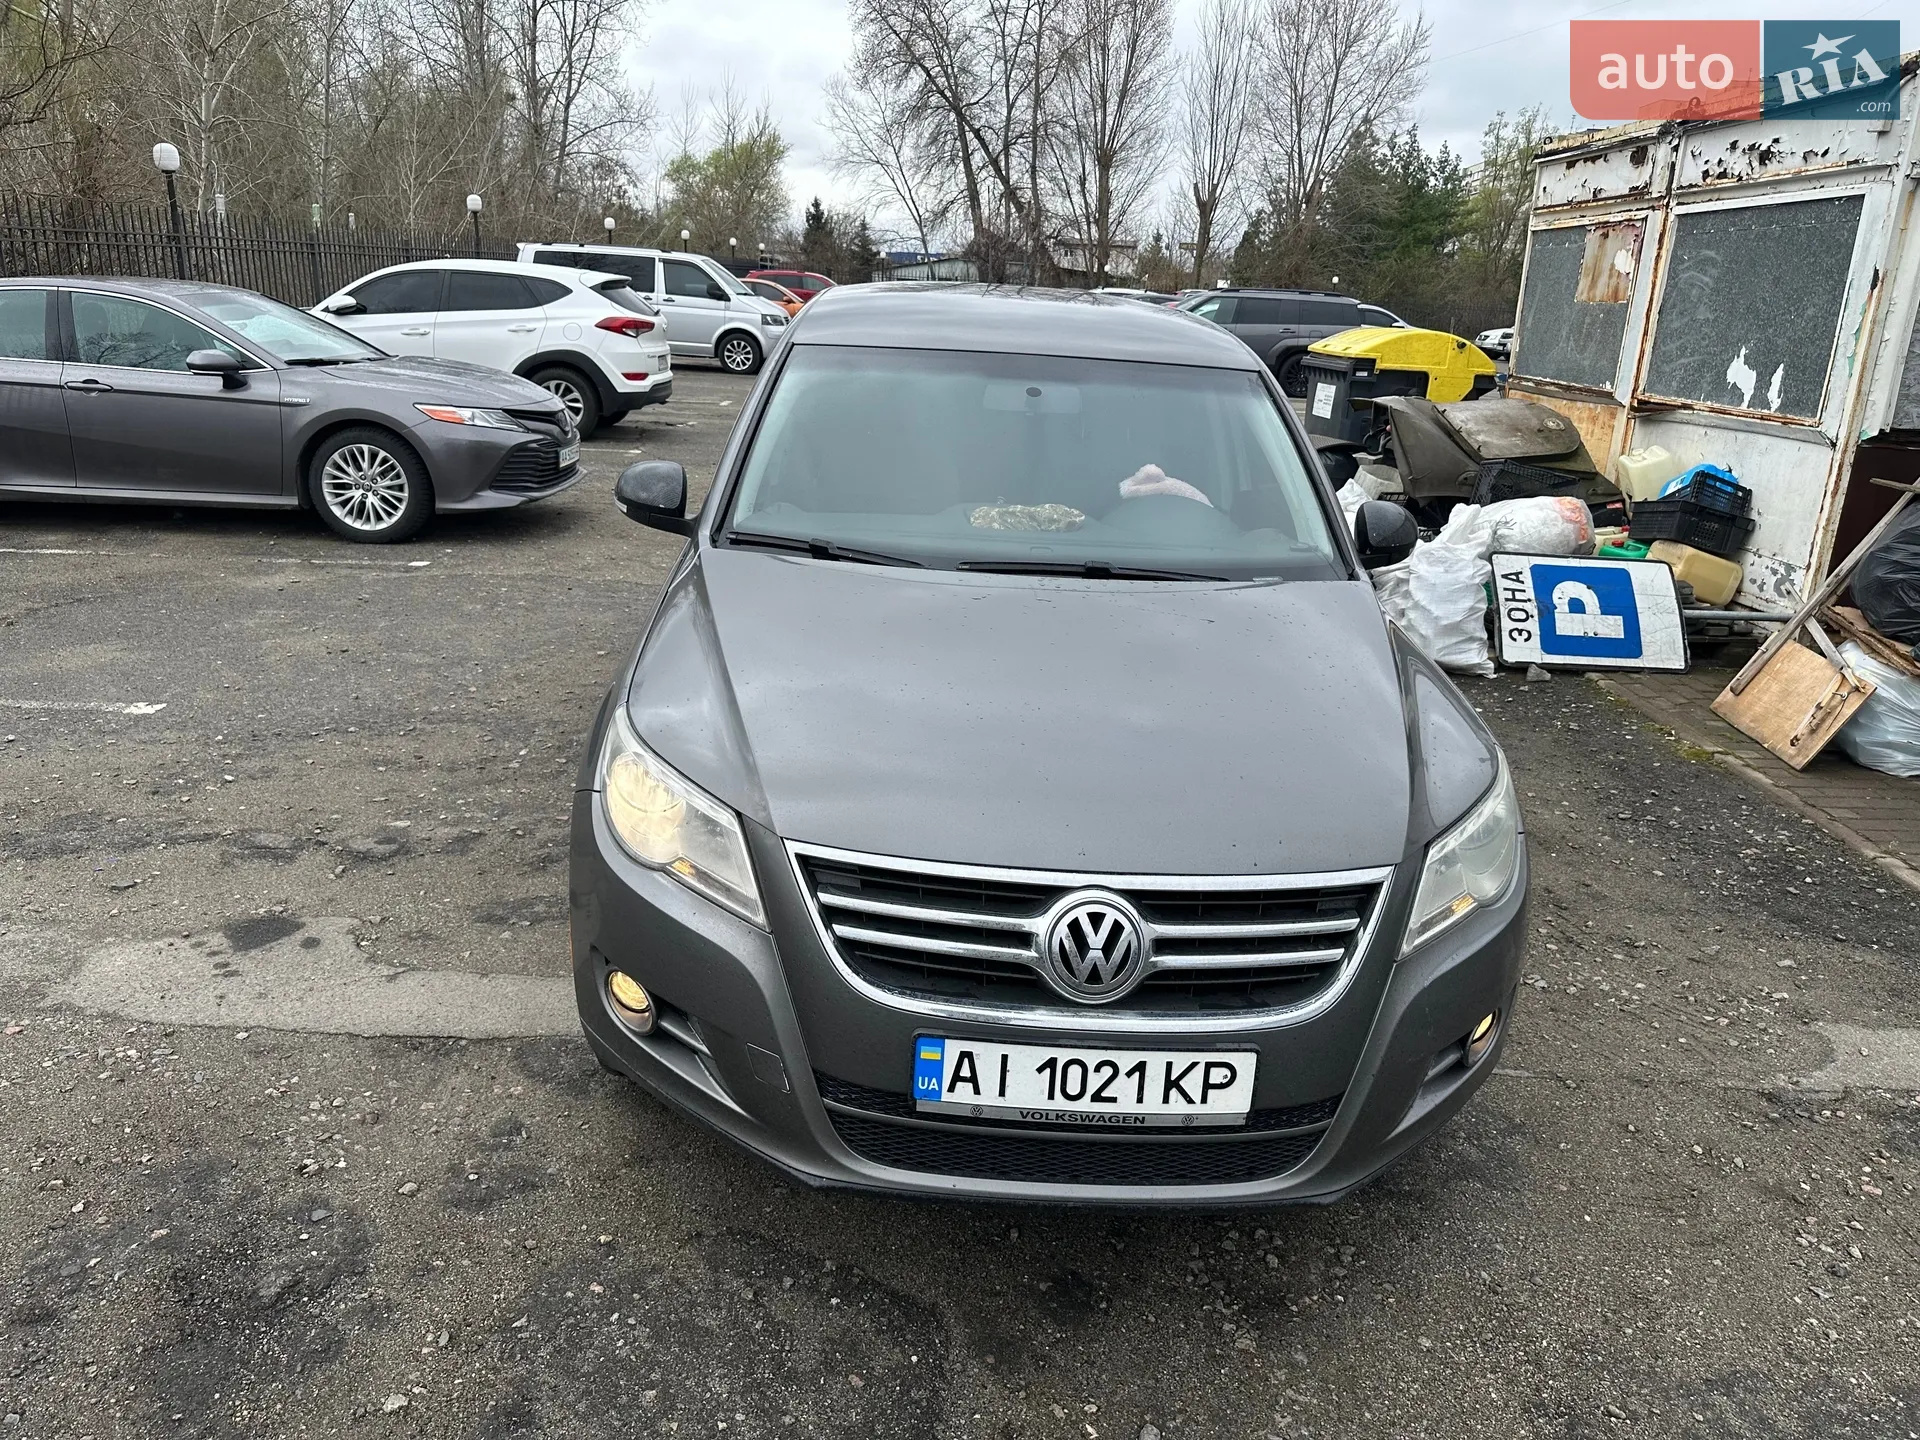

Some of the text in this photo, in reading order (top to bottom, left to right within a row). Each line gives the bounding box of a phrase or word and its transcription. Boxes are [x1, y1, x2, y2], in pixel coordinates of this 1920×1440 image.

[1501, 570, 1532, 643] ЗОНА
[1552, 580, 1625, 639] P
[917, 1076, 939, 1091] UA
[946, 1050, 1238, 1106] AI 1021 KP
[1019, 1110, 1146, 1126] VOLKSWAGEN
